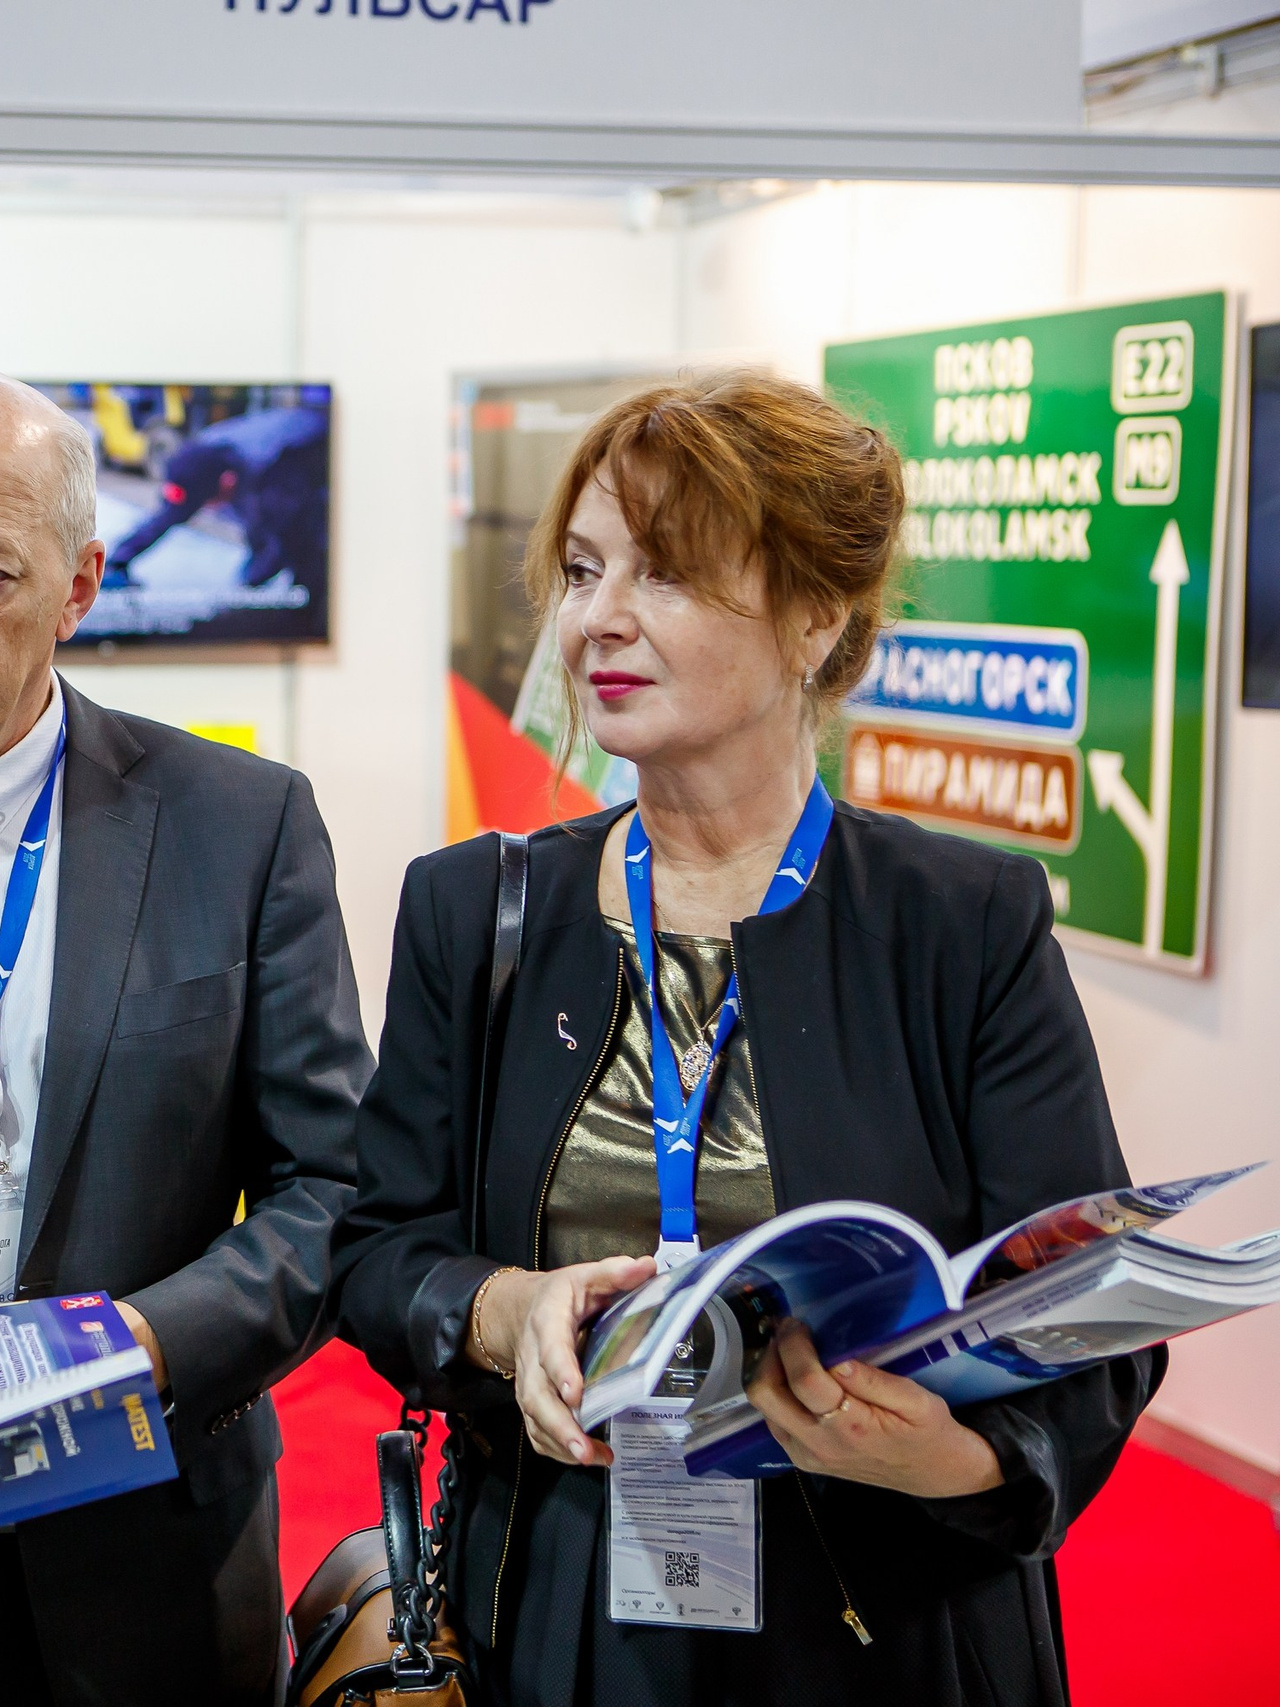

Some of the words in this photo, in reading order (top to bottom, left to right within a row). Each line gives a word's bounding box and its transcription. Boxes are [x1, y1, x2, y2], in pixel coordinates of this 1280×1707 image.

[934, 336, 1033, 395] ПСКОВ
[1124, 337, 1184, 397] E22
[933, 390, 1031, 447] PSKOV
[858, 645, 1072, 717] РАСНОГОРСК
[884, 741, 1069, 832] ПИРАМИДА
[630, 1411, 673, 1420] ПОЛЕЗНАЯ
